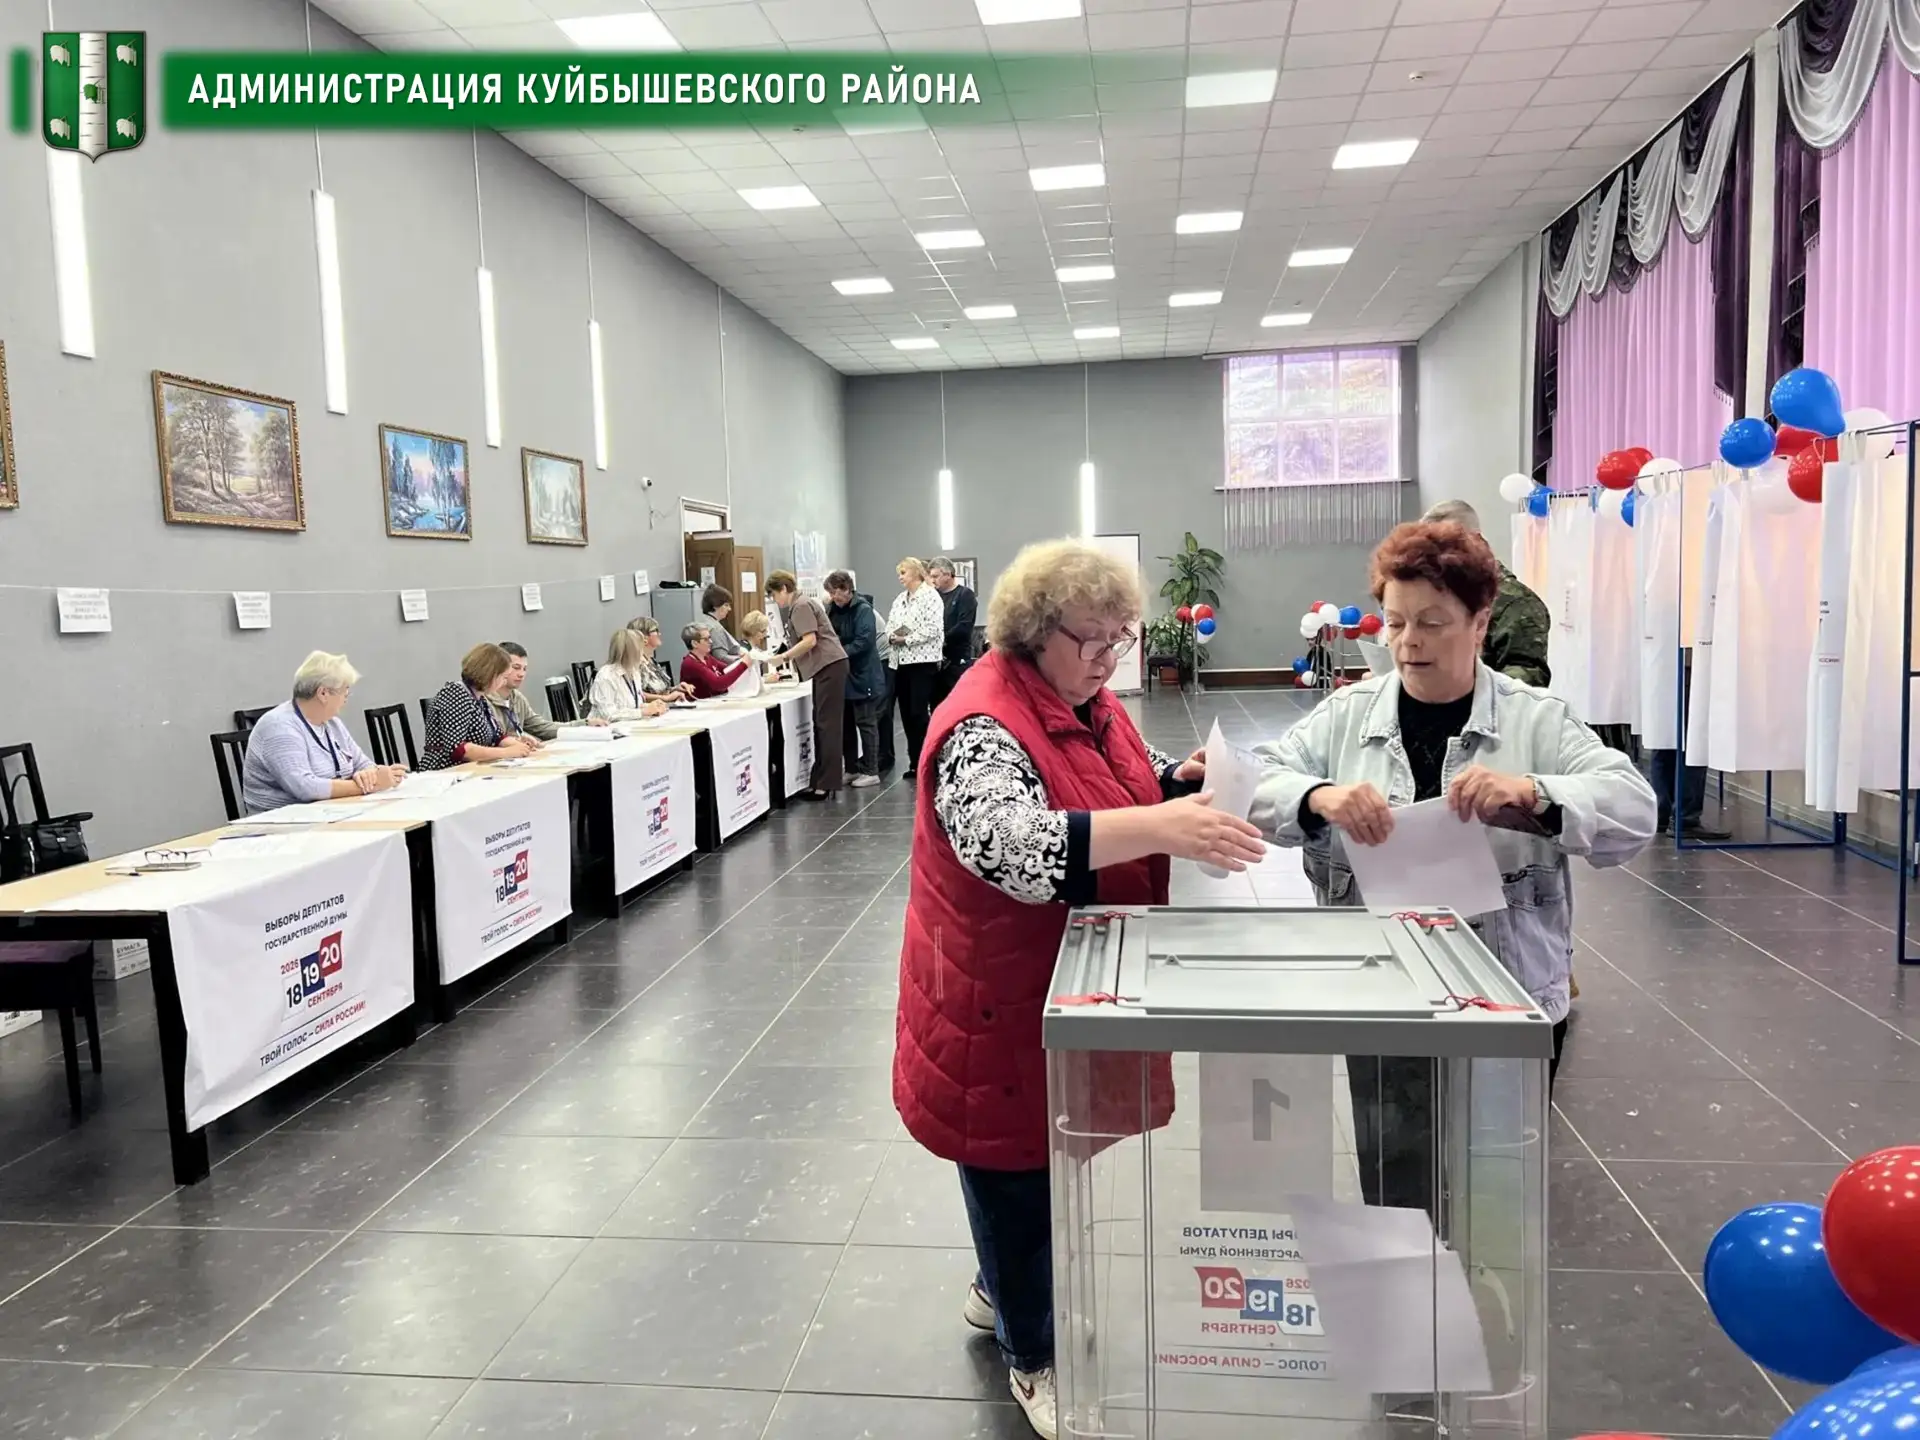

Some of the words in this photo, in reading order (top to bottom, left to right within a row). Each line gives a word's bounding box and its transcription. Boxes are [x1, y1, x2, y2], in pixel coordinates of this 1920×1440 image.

[495, 886, 505, 903] 18
[505, 871, 515, 889] 19
[515, 858, 527, 876] 20
[264, 916, 328, 951] ГОСУДАРСТВЕННОЙ
[329, 911, 348, 926] ДУМЫ
[265, 910, 300, 933] ВЫБОРЫ
[302, 894, 345, 920] ДЕПУТАТОВ
[280, 959, 299, 975] 2026
[286, 983, 302, 1008] 18
[303, 962, 320, 987] 19
[320, 943, 340, 969] 20
[307, 982, 343, 1008] СЕНТЯБРЯ
[260, 1044, 281, 1067] ТВОЙ
[282, 1032, 307, 1054] ГОЛОС
[314, 1018, 334, 1035] СИЛА
